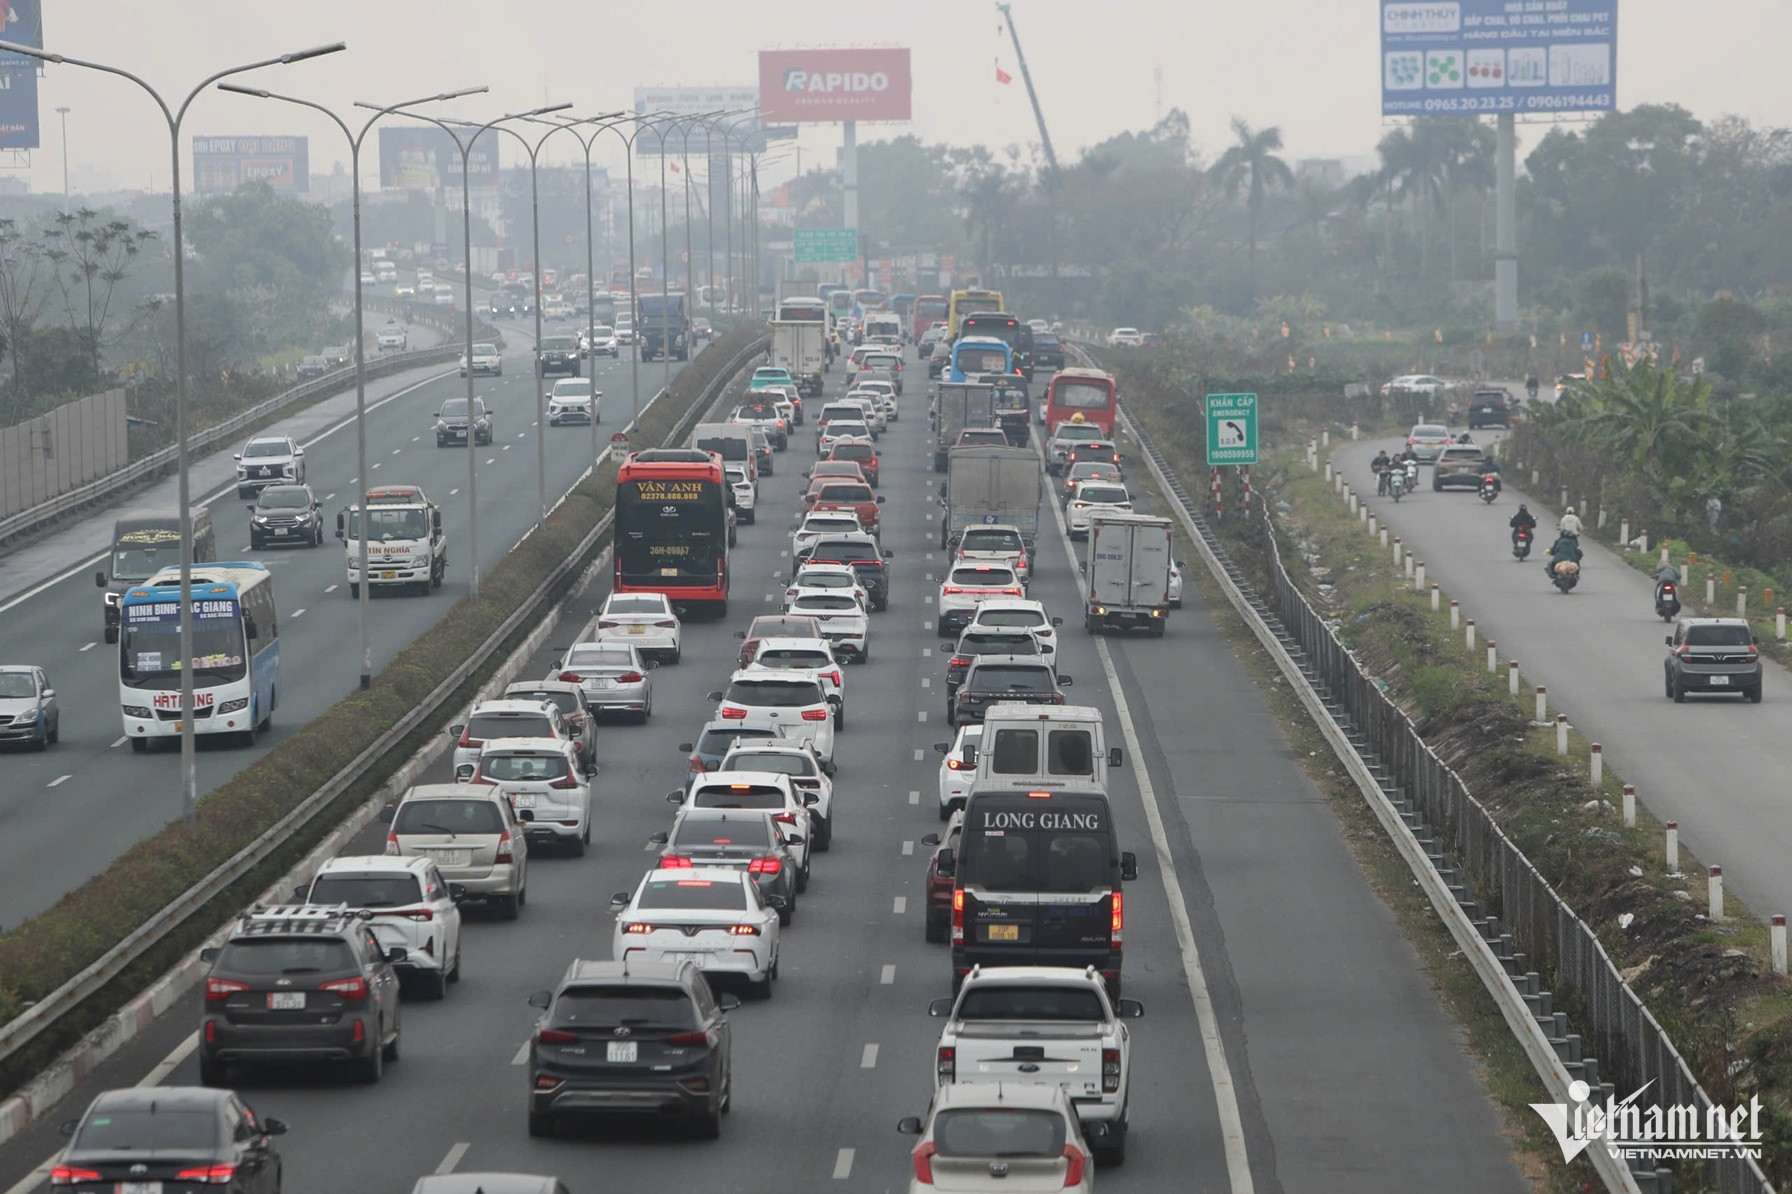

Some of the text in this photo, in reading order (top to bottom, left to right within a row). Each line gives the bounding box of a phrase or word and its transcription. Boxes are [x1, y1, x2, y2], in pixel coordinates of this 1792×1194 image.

[785, 71, 889, 92] RAPIDO
[1424, 98, 1515, 111] 0965.20.23.25
[1527, 94, 1610, 108] 0906194443
[209, 140, 236, 152] EPOXY
[1237, 395, 1254, 407] CẤP
[1213, 409, 1250, 417] EMERGENCY
[637, 481, 703, 492] VÂN ANH
[202, 601, 233, 613] GIANG
[153, 692, 214, 708] HÀTNG
[984, 813, 1099, 830] LONG GIANG
